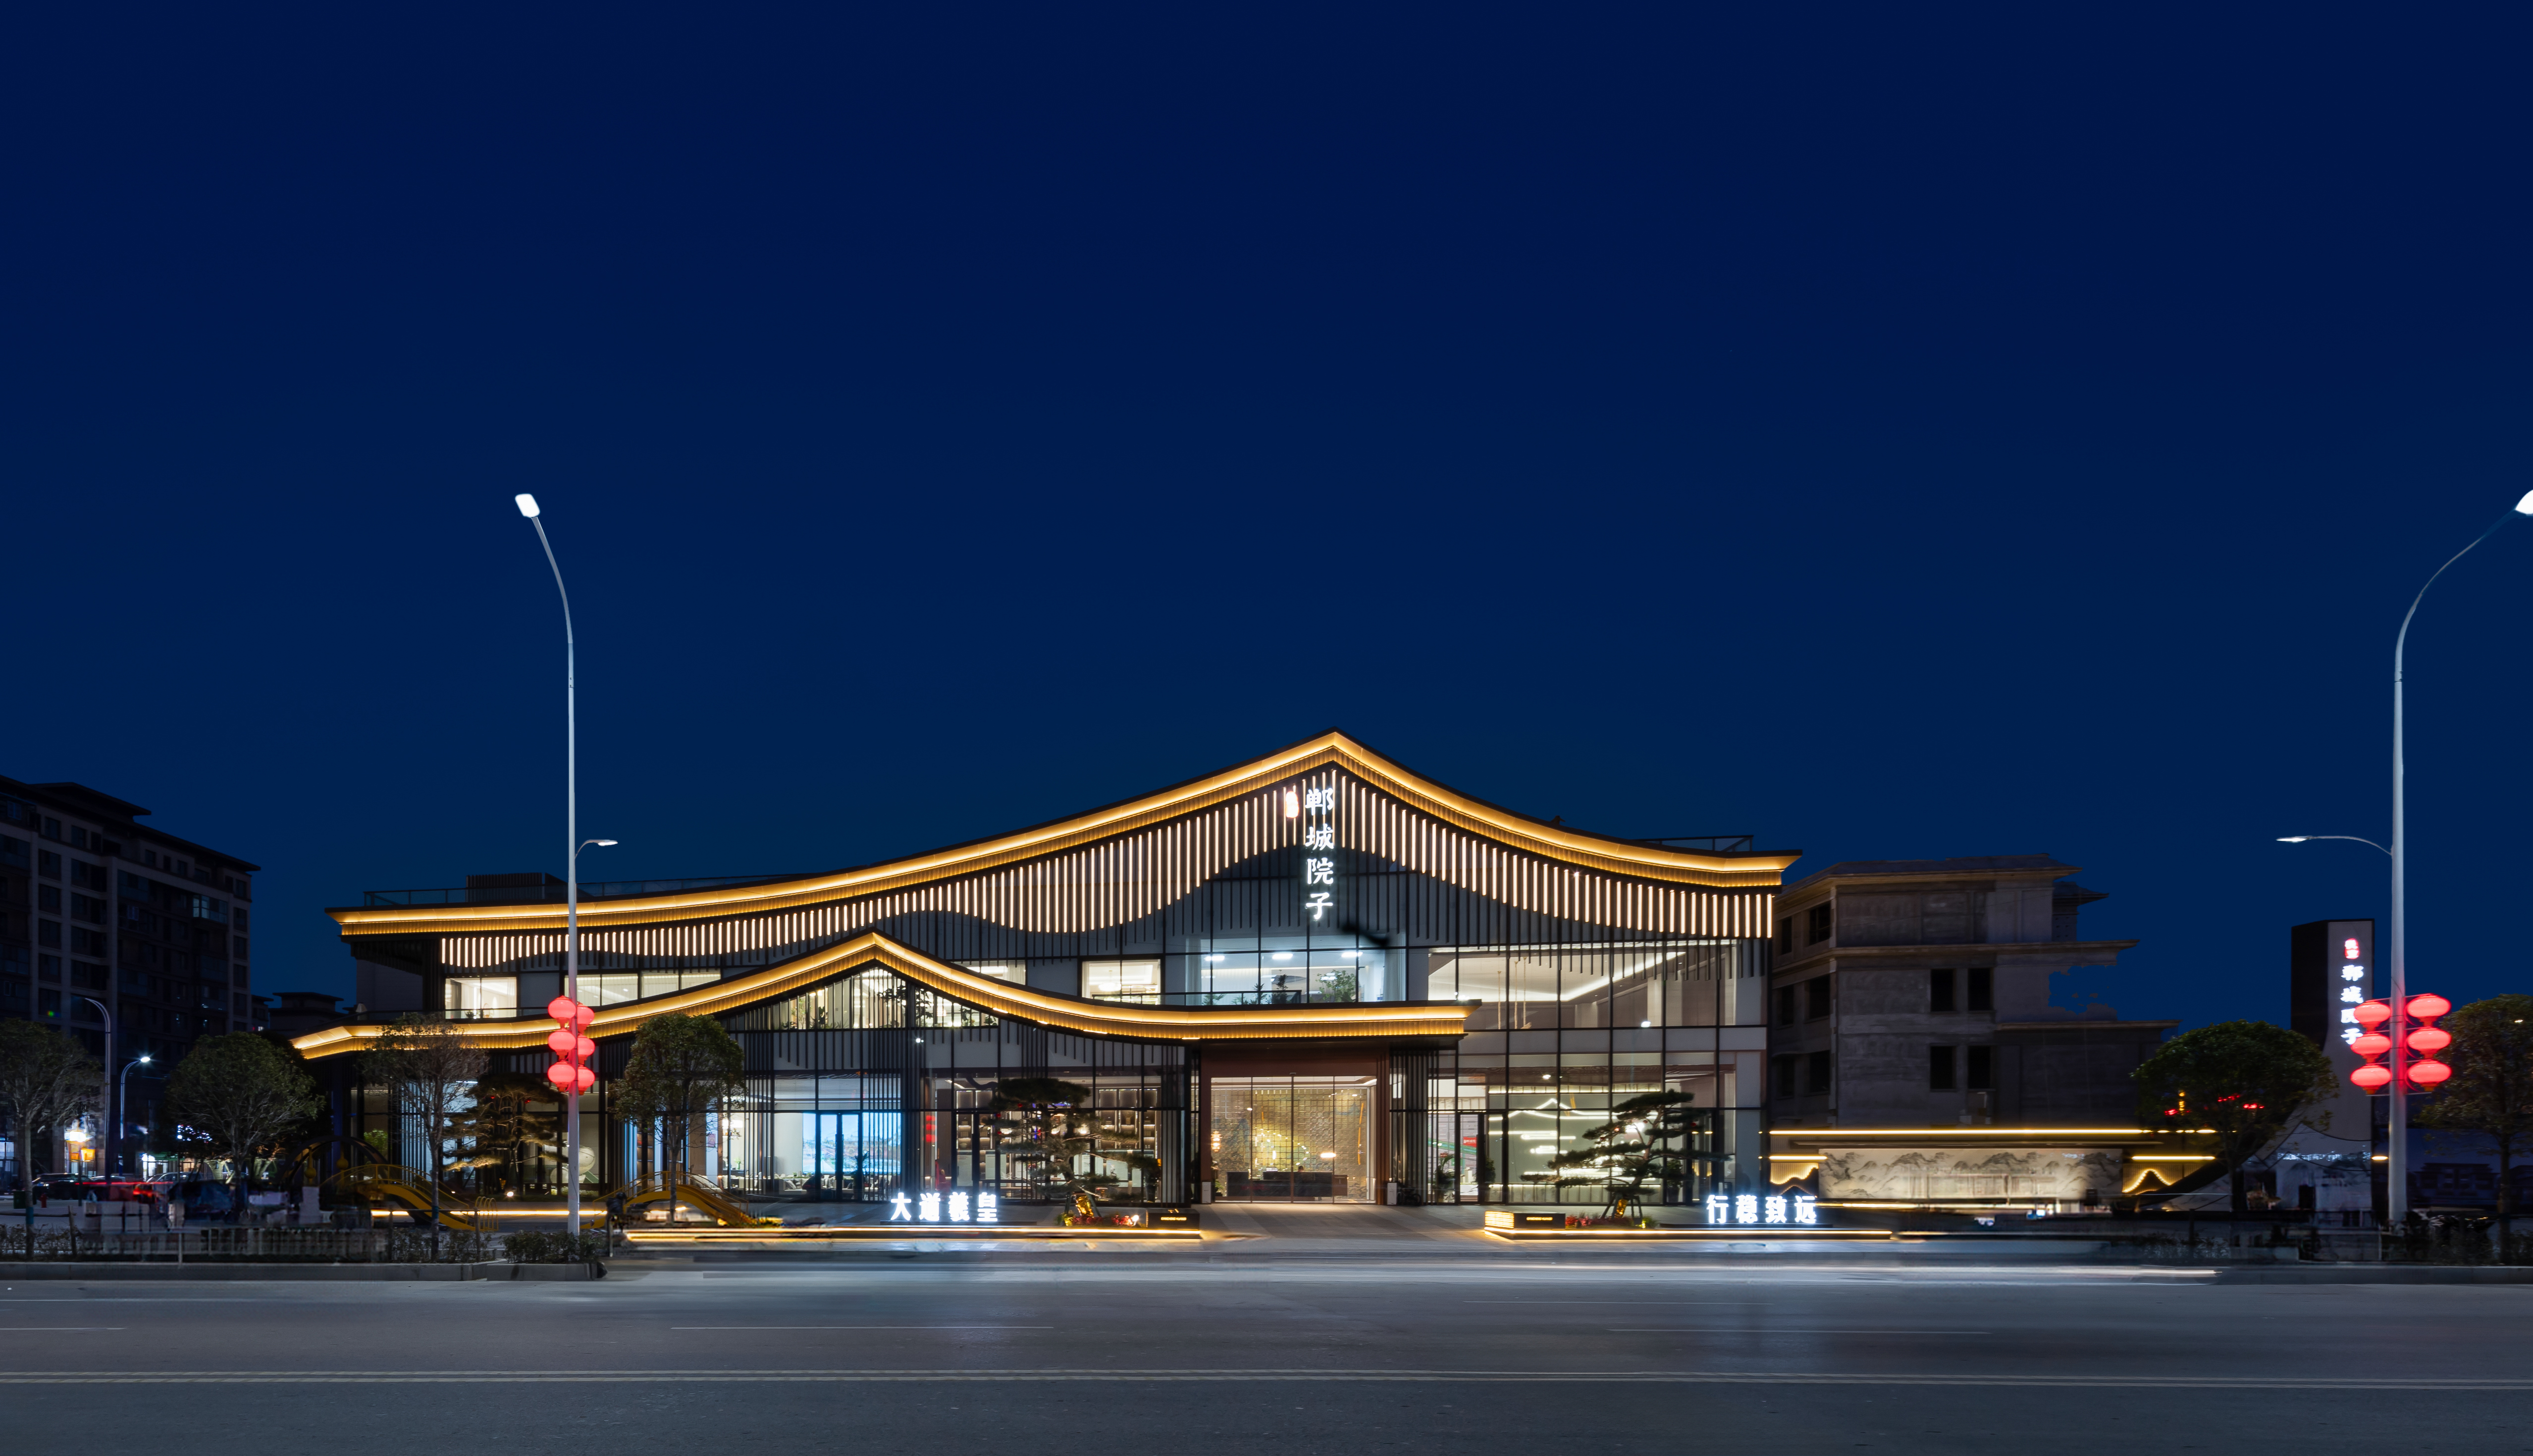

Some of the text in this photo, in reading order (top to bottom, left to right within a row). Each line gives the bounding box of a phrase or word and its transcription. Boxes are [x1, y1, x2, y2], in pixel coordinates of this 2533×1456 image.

[1305, 787, 1334, 920] 郸城院子
[1706, 1195, 1817, 1224] 行稳致远
